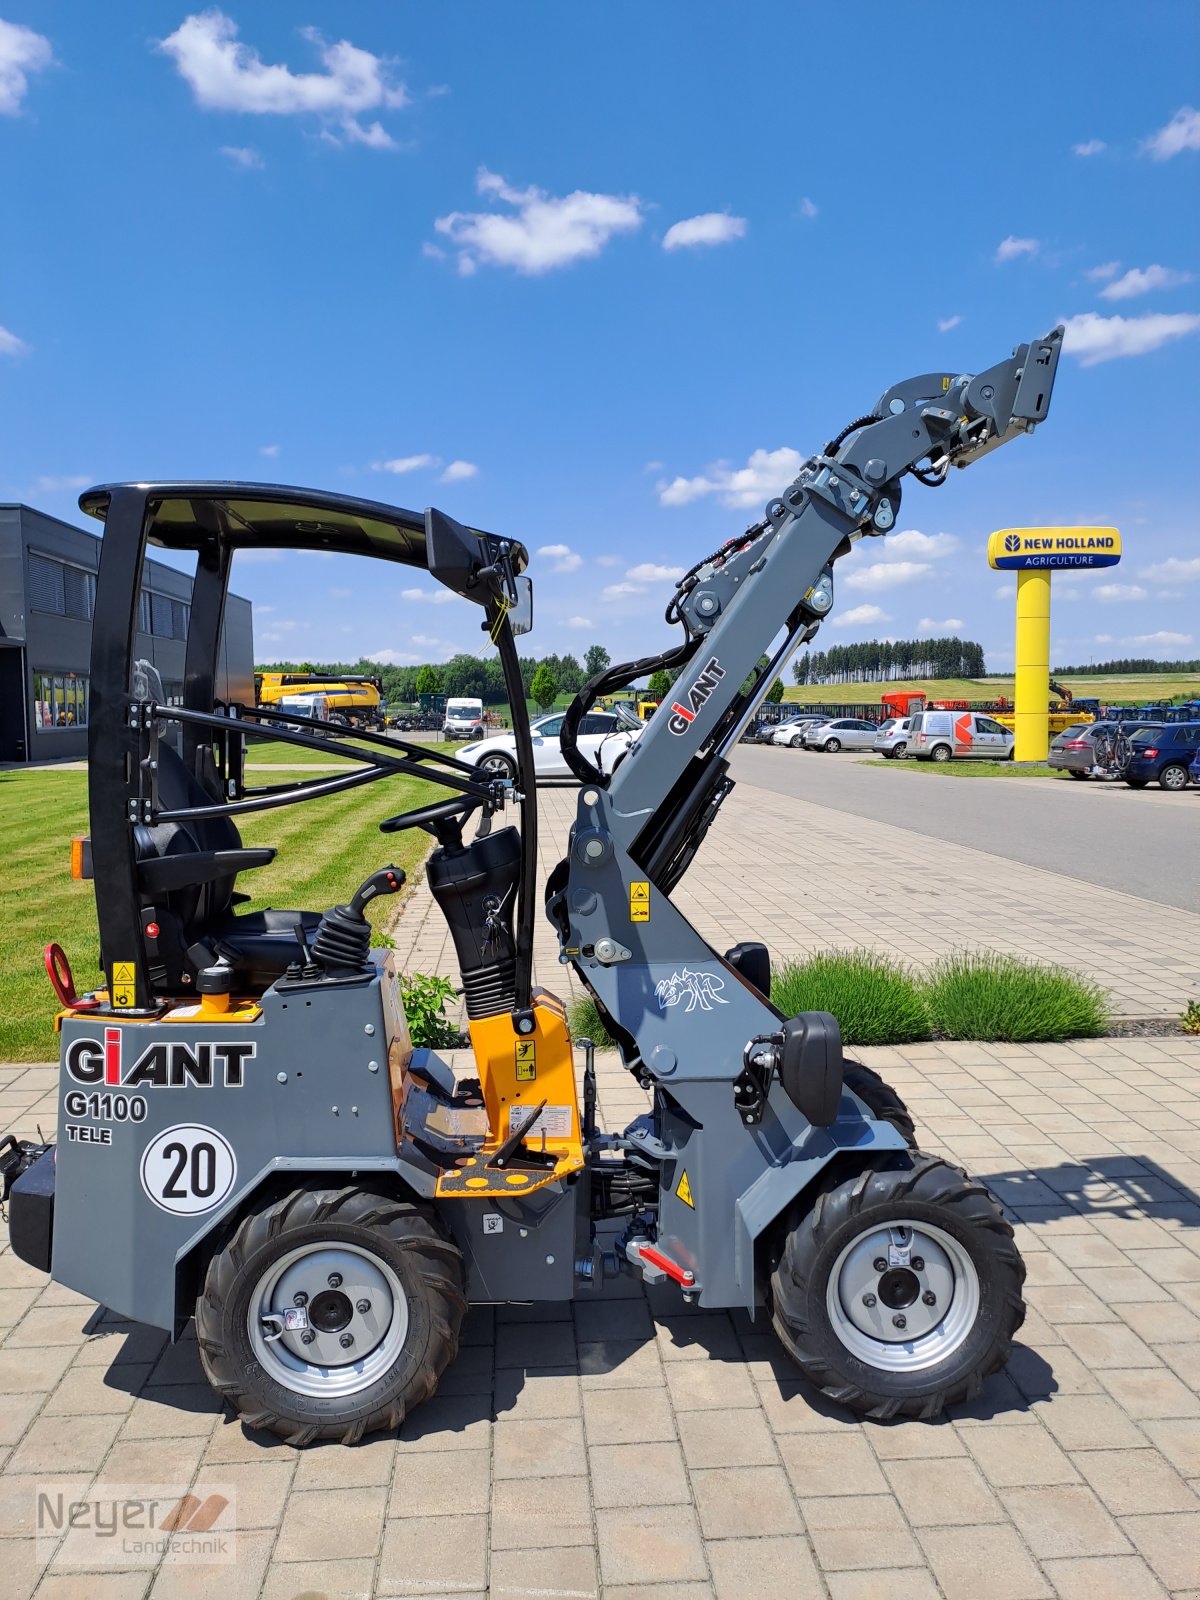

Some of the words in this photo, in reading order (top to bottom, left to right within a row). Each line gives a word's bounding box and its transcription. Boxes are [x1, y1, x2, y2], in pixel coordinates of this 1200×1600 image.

[1024, 538, 1053, 549] NEW
[1056, 537, 1114, 548] HOLLAND
[1025, 556, 1094, 565] AGRICULTURE
[65, 1091, 147, 1123] G1100
[66, 1125, 112, 1145] TELE
[162, 1142, 216, 1198] 20
